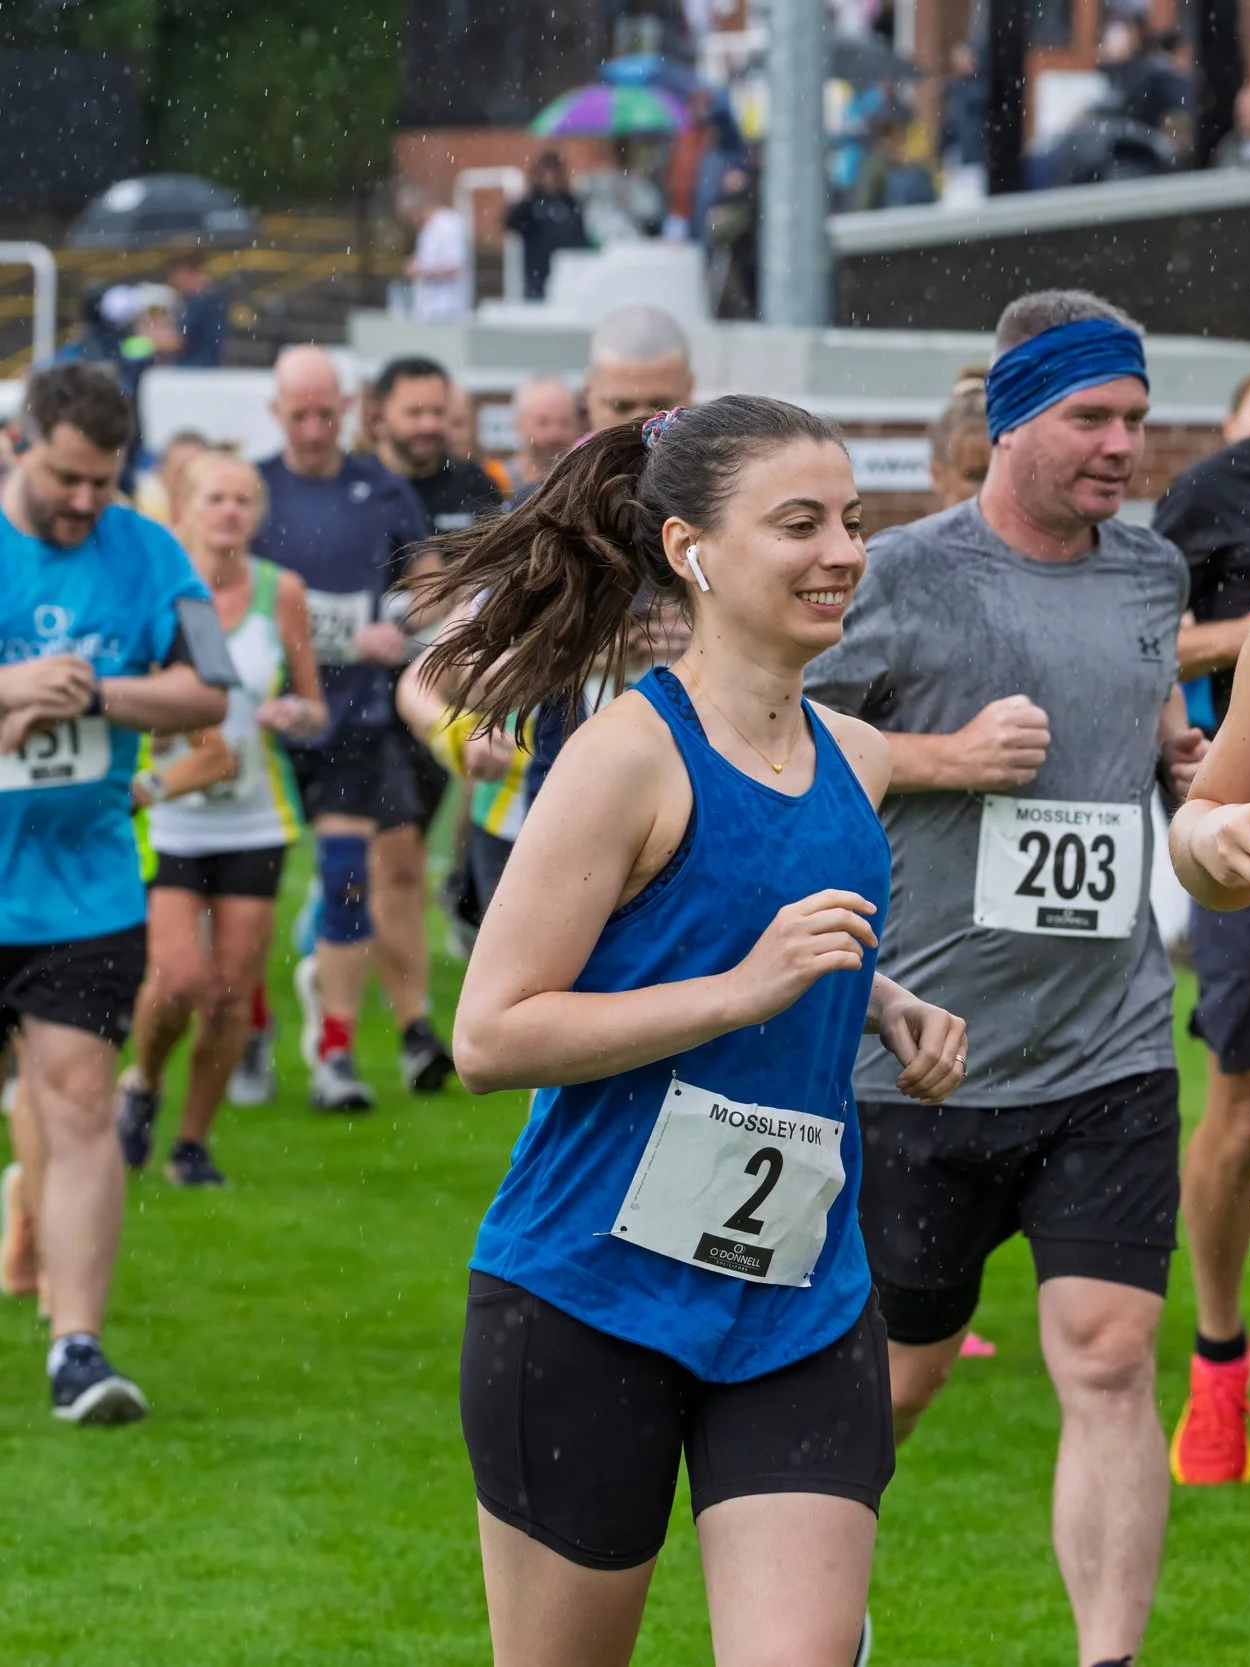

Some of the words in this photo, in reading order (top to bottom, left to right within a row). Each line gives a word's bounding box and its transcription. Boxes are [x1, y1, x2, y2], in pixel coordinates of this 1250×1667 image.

[1016, 808, 1093, 825] MOSSLEY
[1097, 812, 1121, 826] 10K
[1014, 831, 1116, 901] 203
[709, 1103, 797, 1140] MOSSLEY
[800, 1124, 822, 1145] 10K
[722, 1146, 784, 1236] 2
[709, 1247, 760, 1268] O'DONNELL
